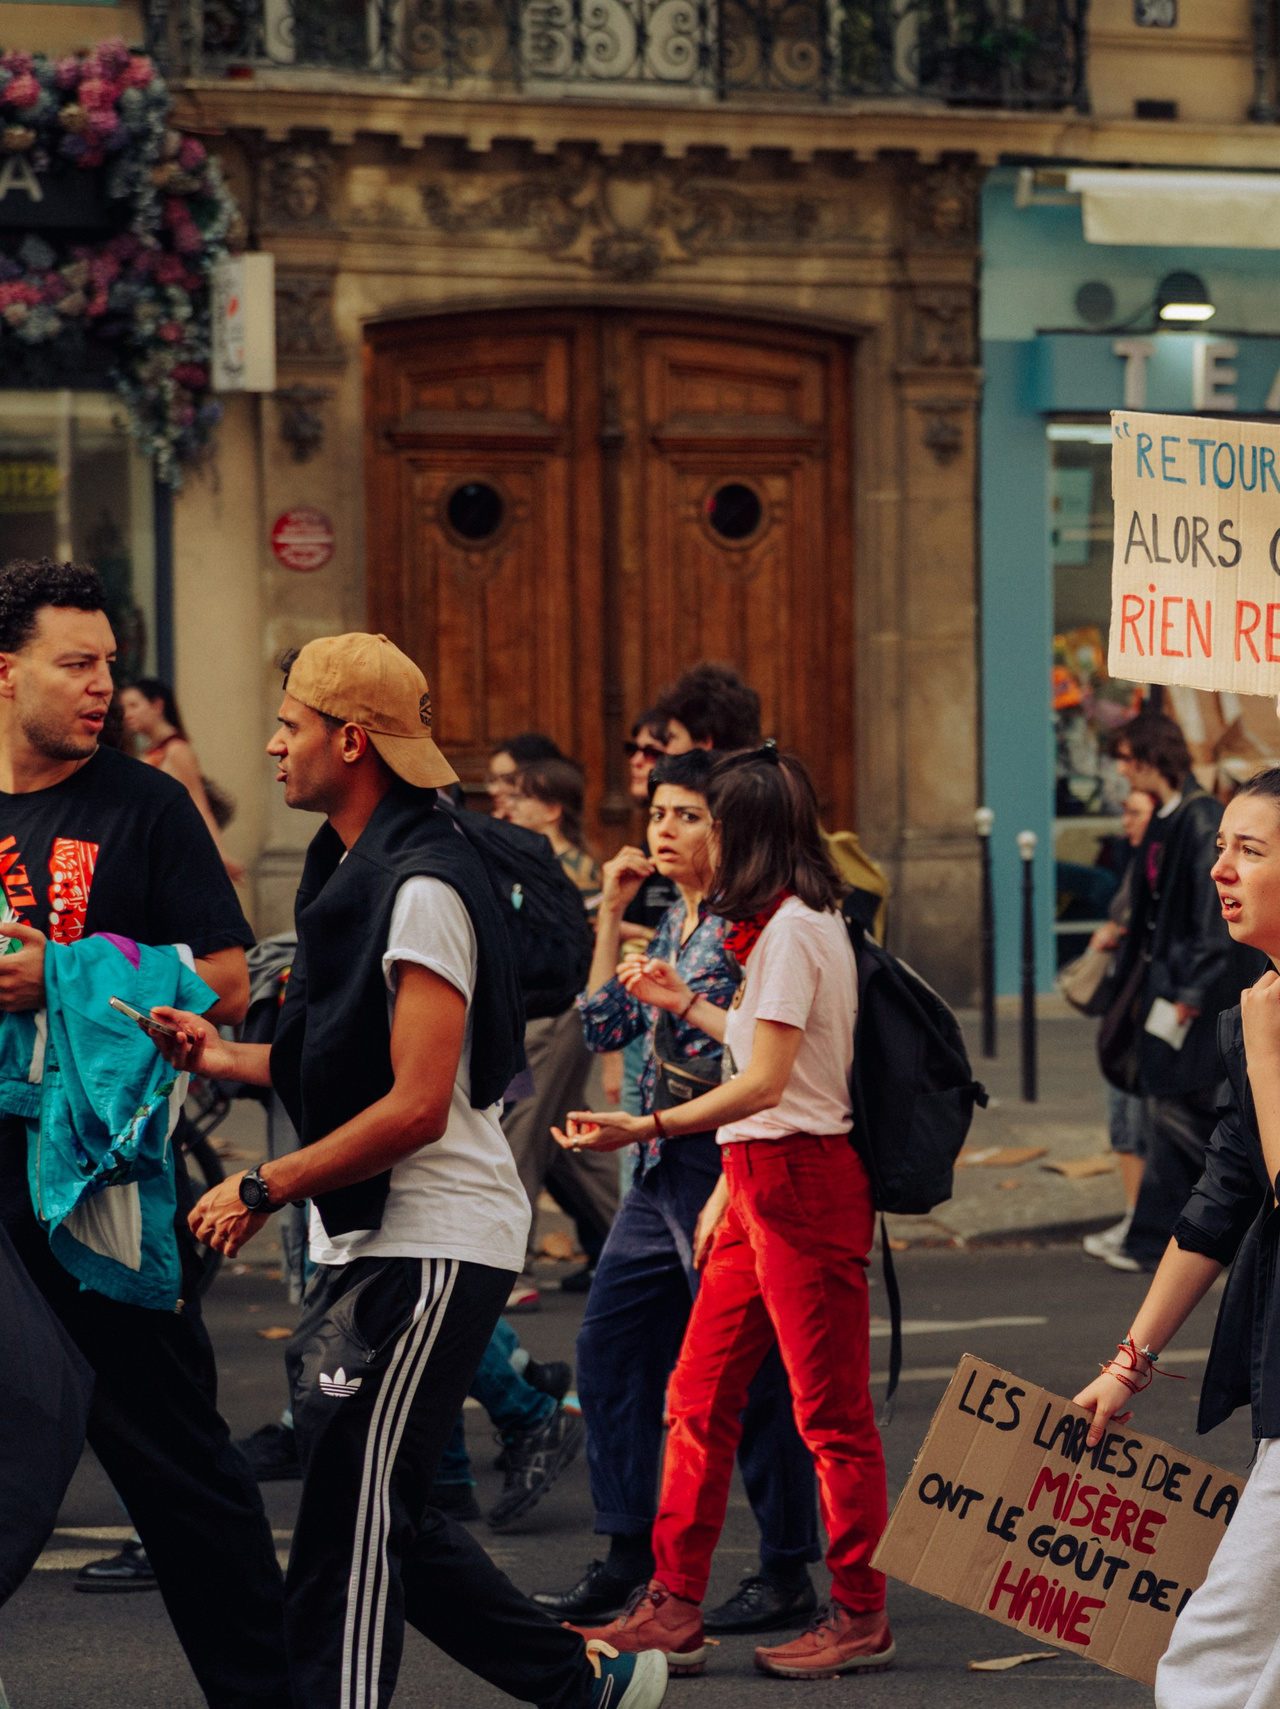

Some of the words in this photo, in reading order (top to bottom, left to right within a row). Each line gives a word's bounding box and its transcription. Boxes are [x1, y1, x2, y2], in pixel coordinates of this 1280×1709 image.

[1125, 511, 1242, 568] ALORS
[958, 1369, 1026, 1431] LES
[1033, 1403, 1143, 1478] LARMES
[1141, 1454, 1191, 1502] DE
[1193, 1474, 1240, 1526] LA
[918, 1473, 984, 1519] ONT
[987, 1497, 1025, 1542] LE
[1028, 1525, 1130, 1590] GOÛT
[1128, 1570, 1179, 1612] DE
